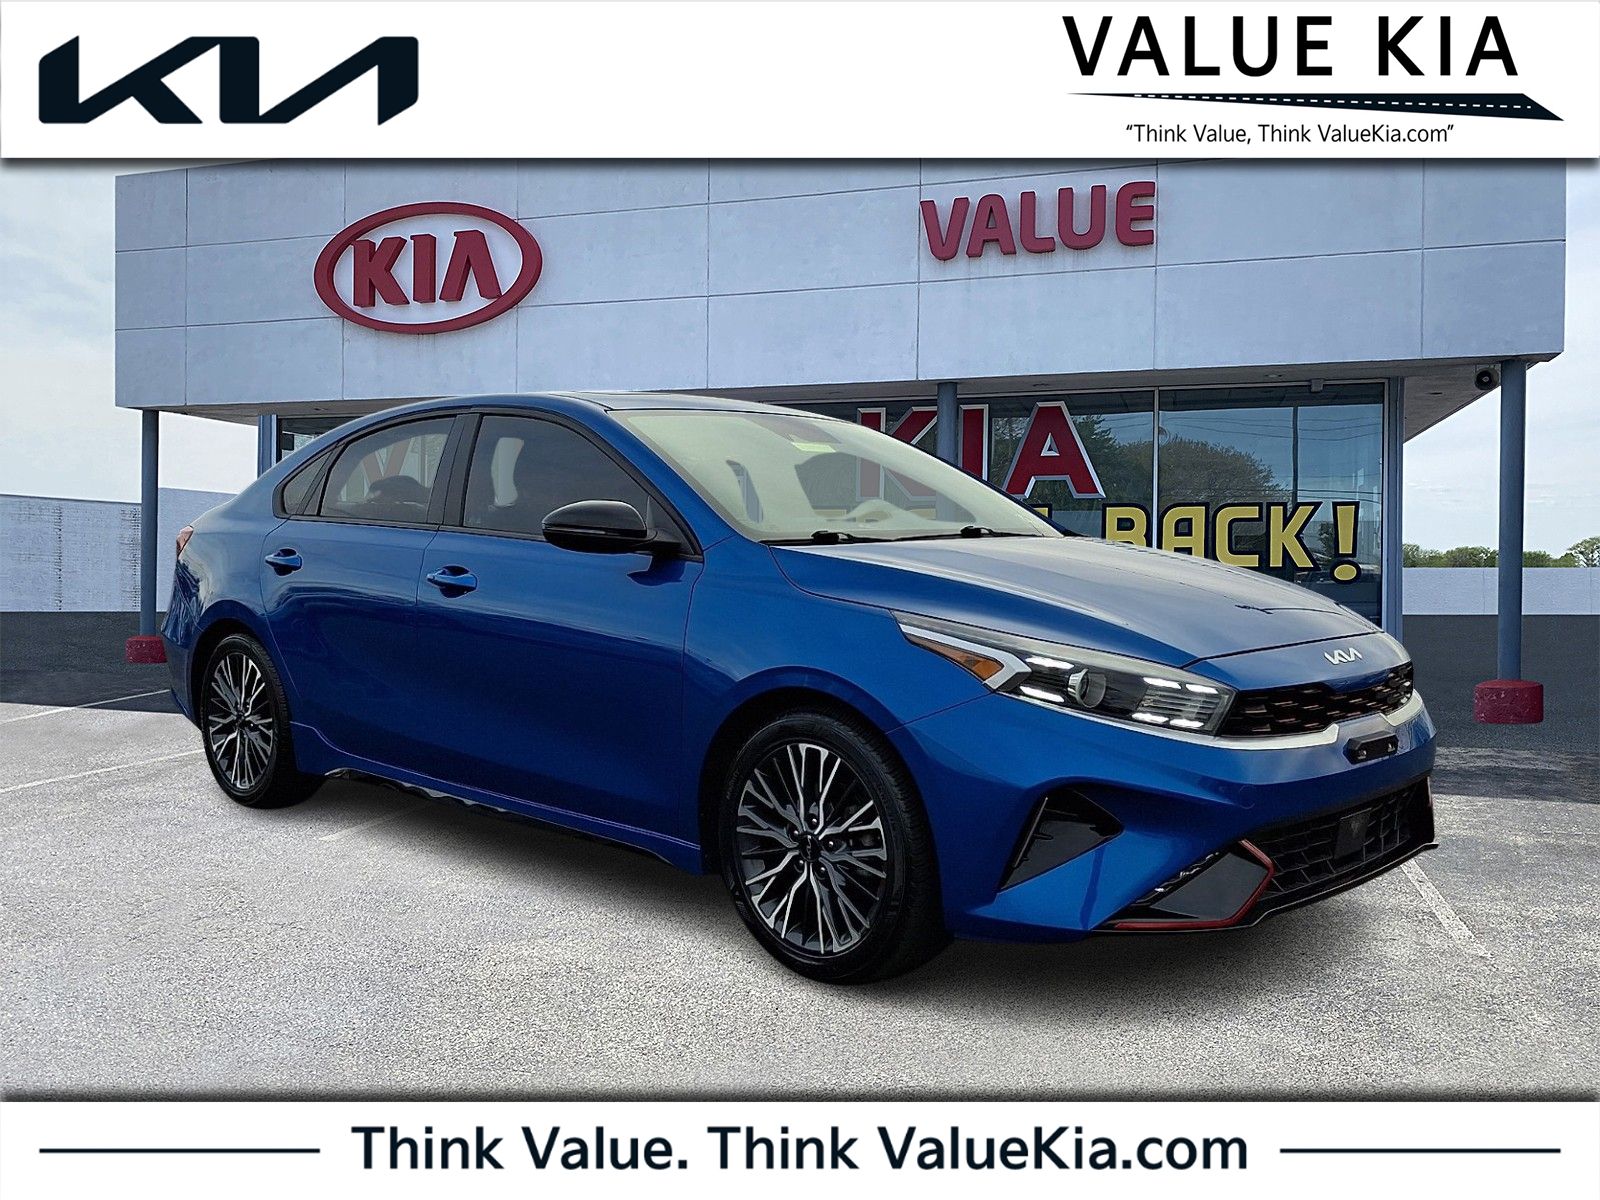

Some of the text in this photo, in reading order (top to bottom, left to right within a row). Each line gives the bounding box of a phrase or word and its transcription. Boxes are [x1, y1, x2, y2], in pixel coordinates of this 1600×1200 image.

[920, 181, 1156, 261] VALUE
[350, 229, 503, 308] KIA
[857, 402, 1107, 500] KIA
[1102, 501, 1361, 584] BACK!
